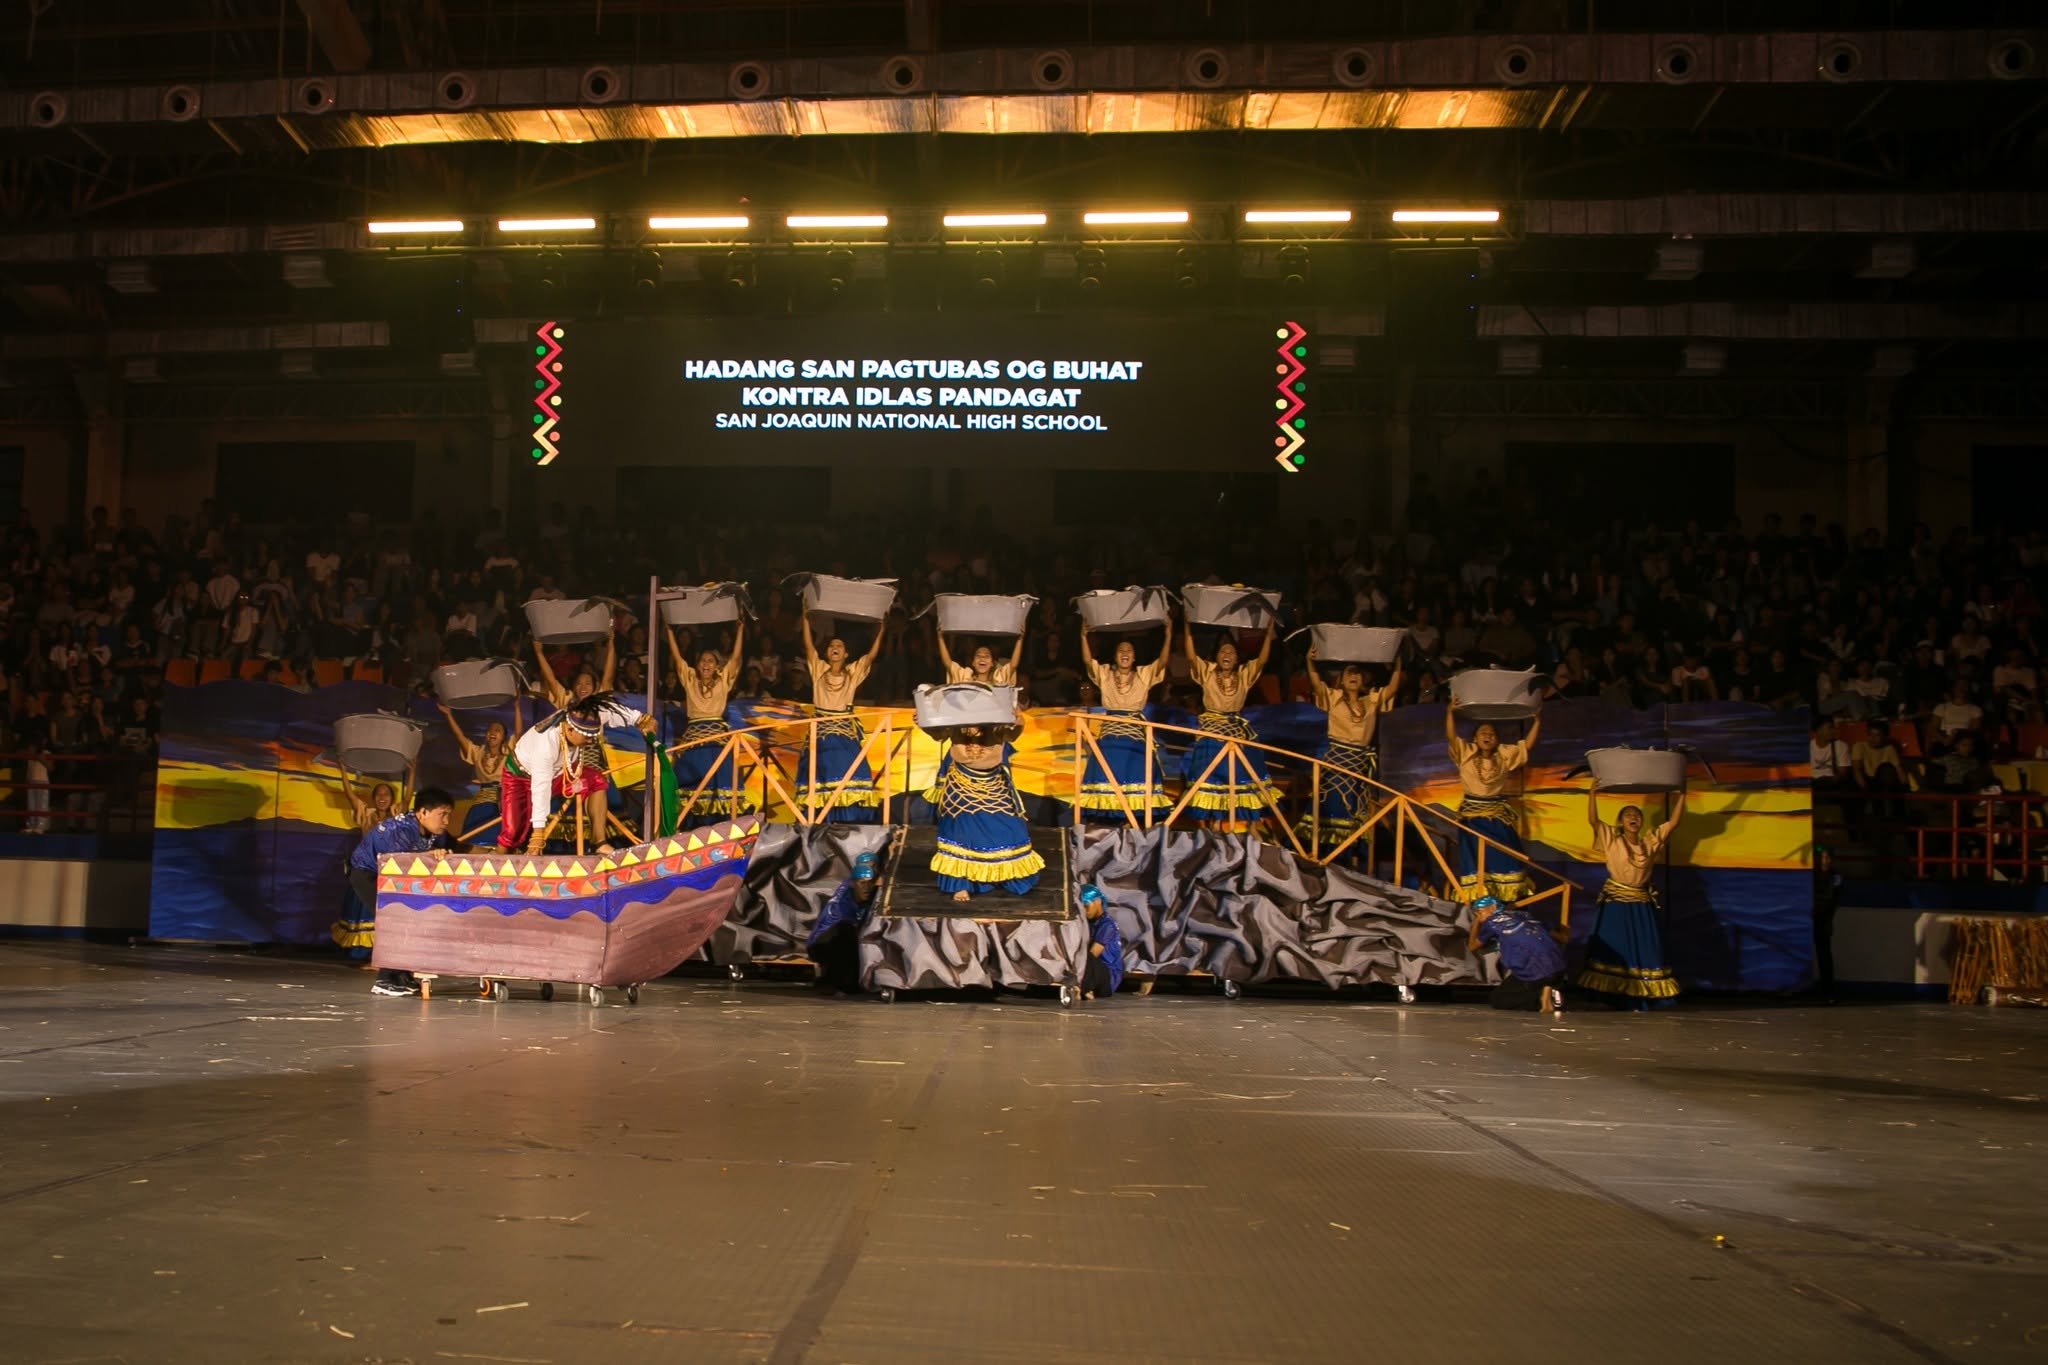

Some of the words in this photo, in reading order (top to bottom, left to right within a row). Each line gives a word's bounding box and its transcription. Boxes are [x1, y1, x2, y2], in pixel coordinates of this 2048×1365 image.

[685, 359, 796, 379] HADANG
[800, 359, 855, 379] SAN
[861, 359, 1001, 380] PAGTUBAS
[1006, 359, 1047, 380] OG
[1052, 360, 1143, 381] BUHAT
[742, 386, 850, 406] KONTRA
[855, 386, 933, 407] IDLAS
[938, 387, 1082, 408] PANDAGAT
[715, 412, 757, 429] SAN
[760, 412, 852, 429] JOAQUIN
[857, 413, 962, 429] NATIONAL
[966, 413, 1017, 430] HIGH
[1021, 414, 1108, 431] SCHOOL
